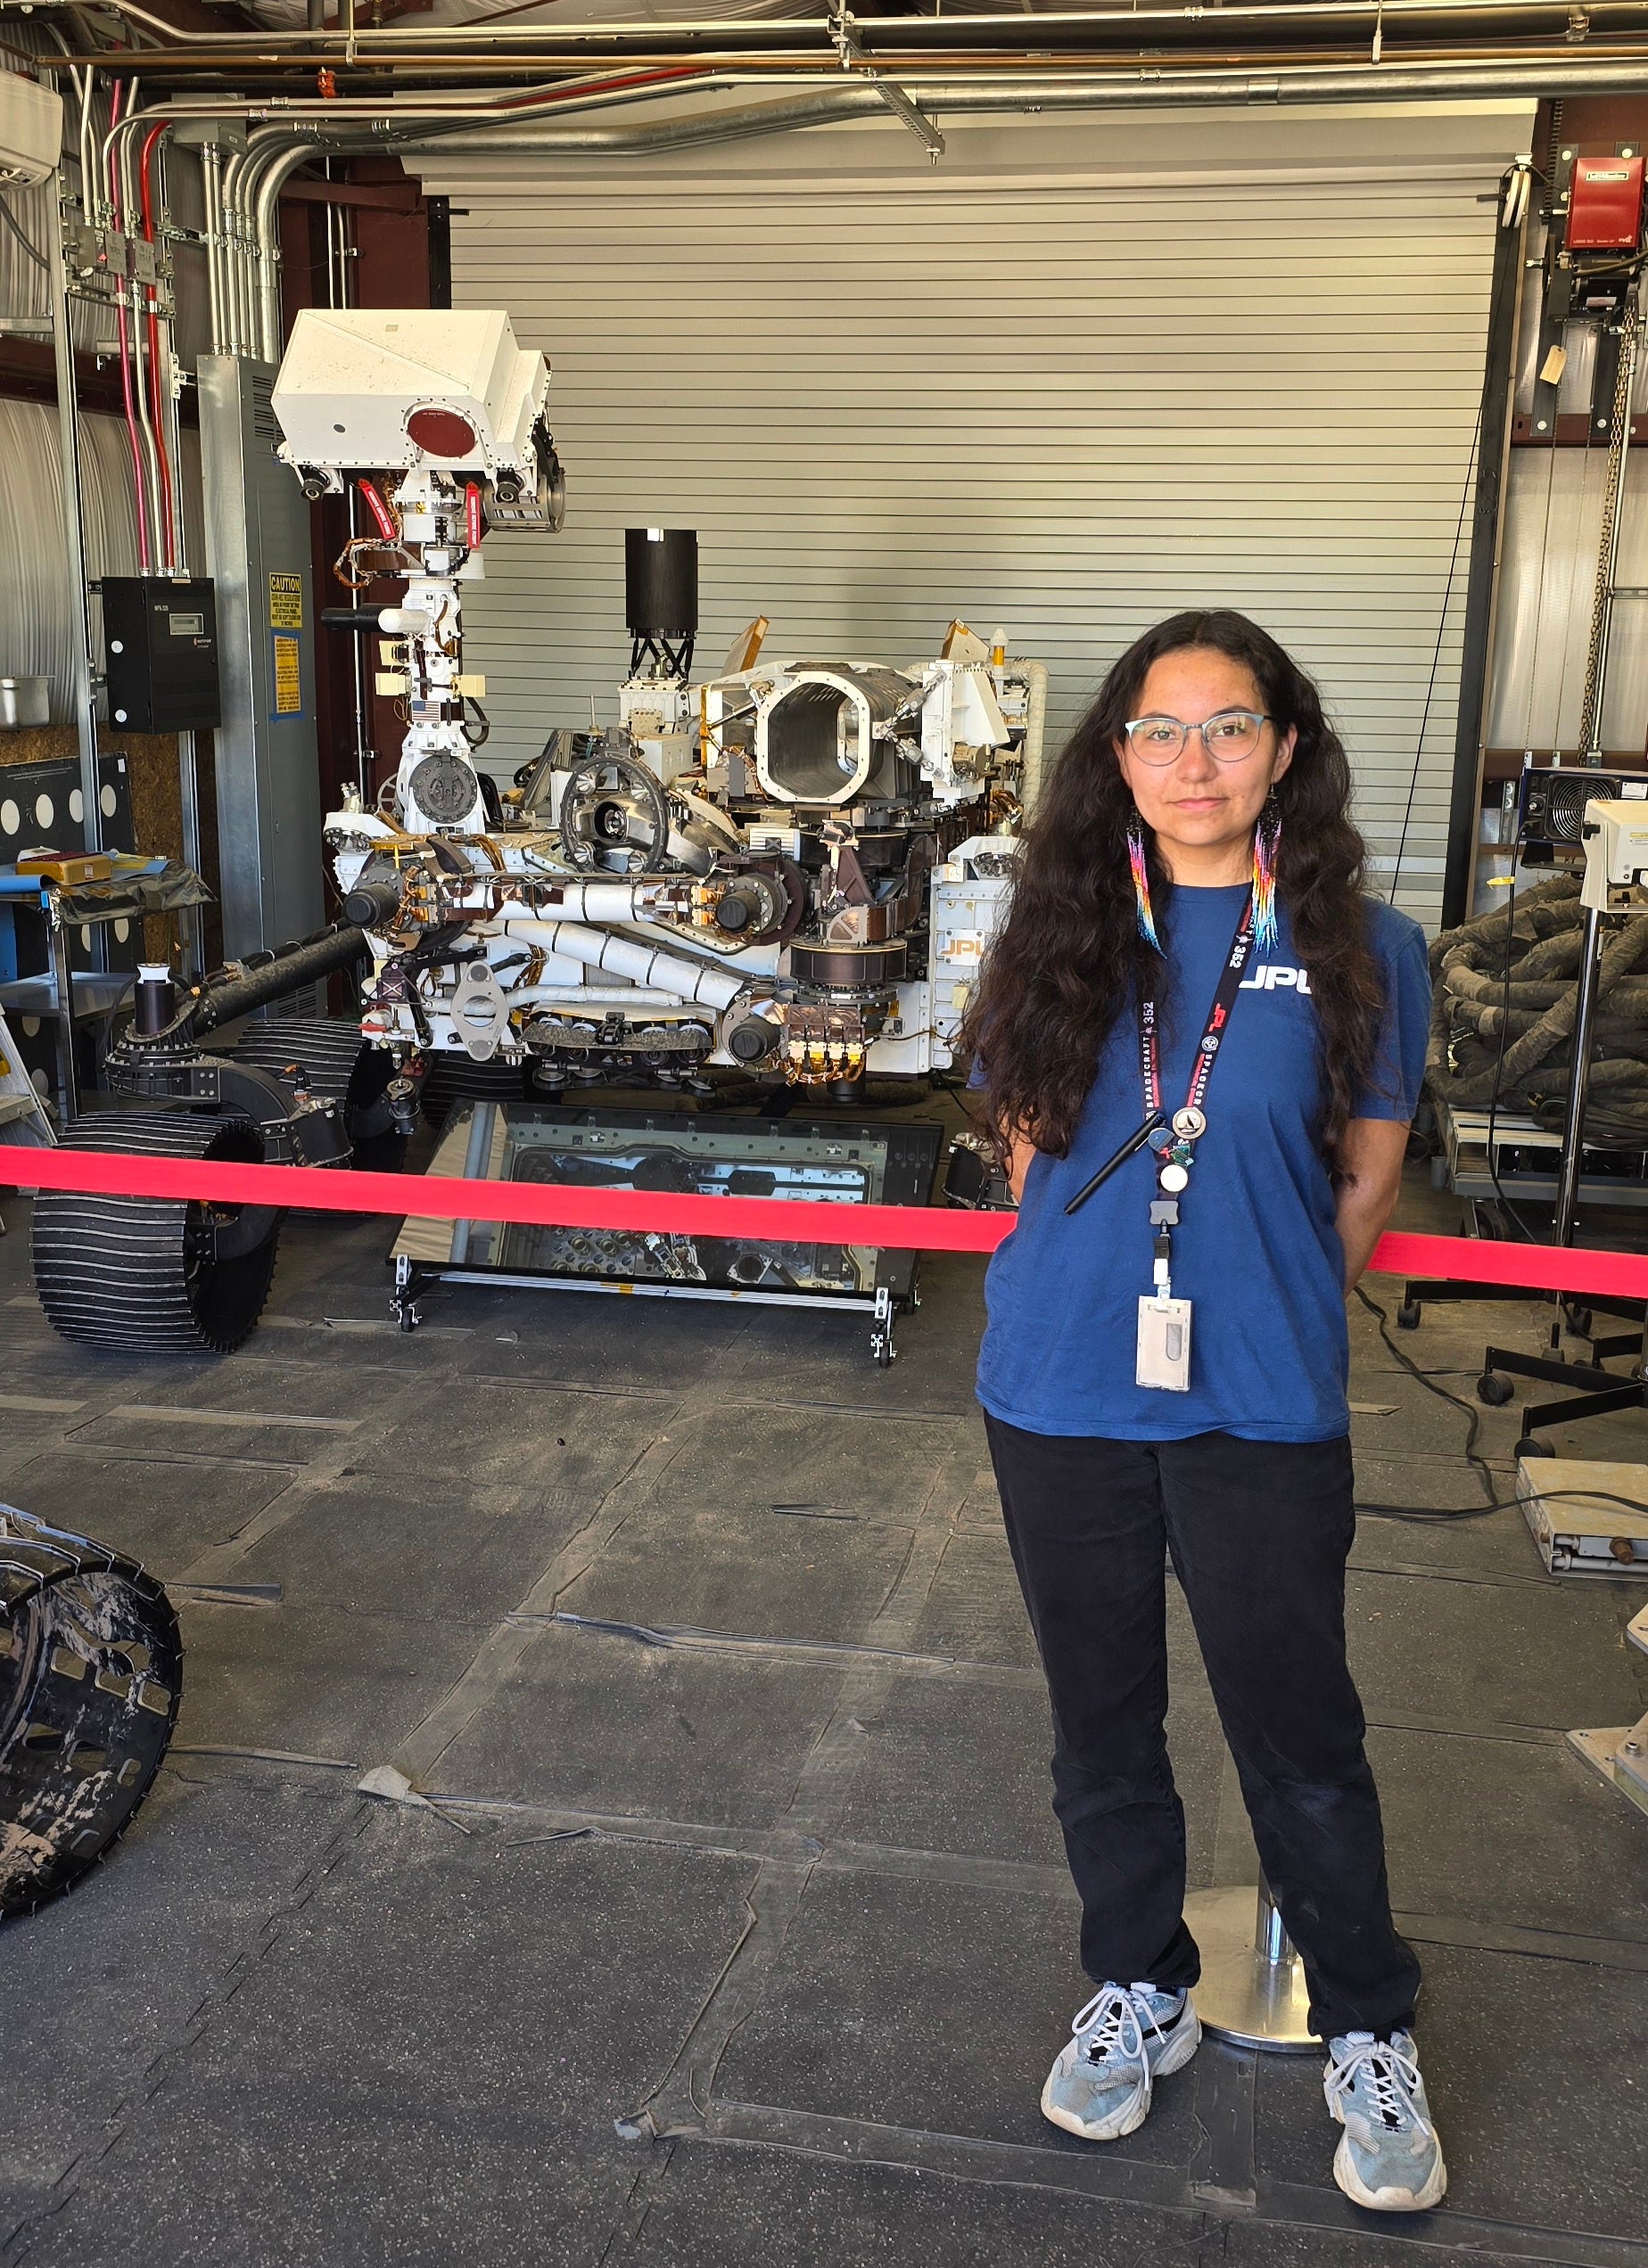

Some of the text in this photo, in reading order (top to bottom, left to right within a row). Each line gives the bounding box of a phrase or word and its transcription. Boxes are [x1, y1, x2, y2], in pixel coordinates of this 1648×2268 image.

[271, 576, 301, 592] CAUTION
[941, 939, 984, 957] JPL
[1230, 945, 1247, 968] 352
[1238, 965, 1313, 995] JPL
[1143, 1001, 1155, 1024] 352
[1208, 1002, 1227, 1032] JPL
[1192, 1053, 1214, 1105] SPACECR
